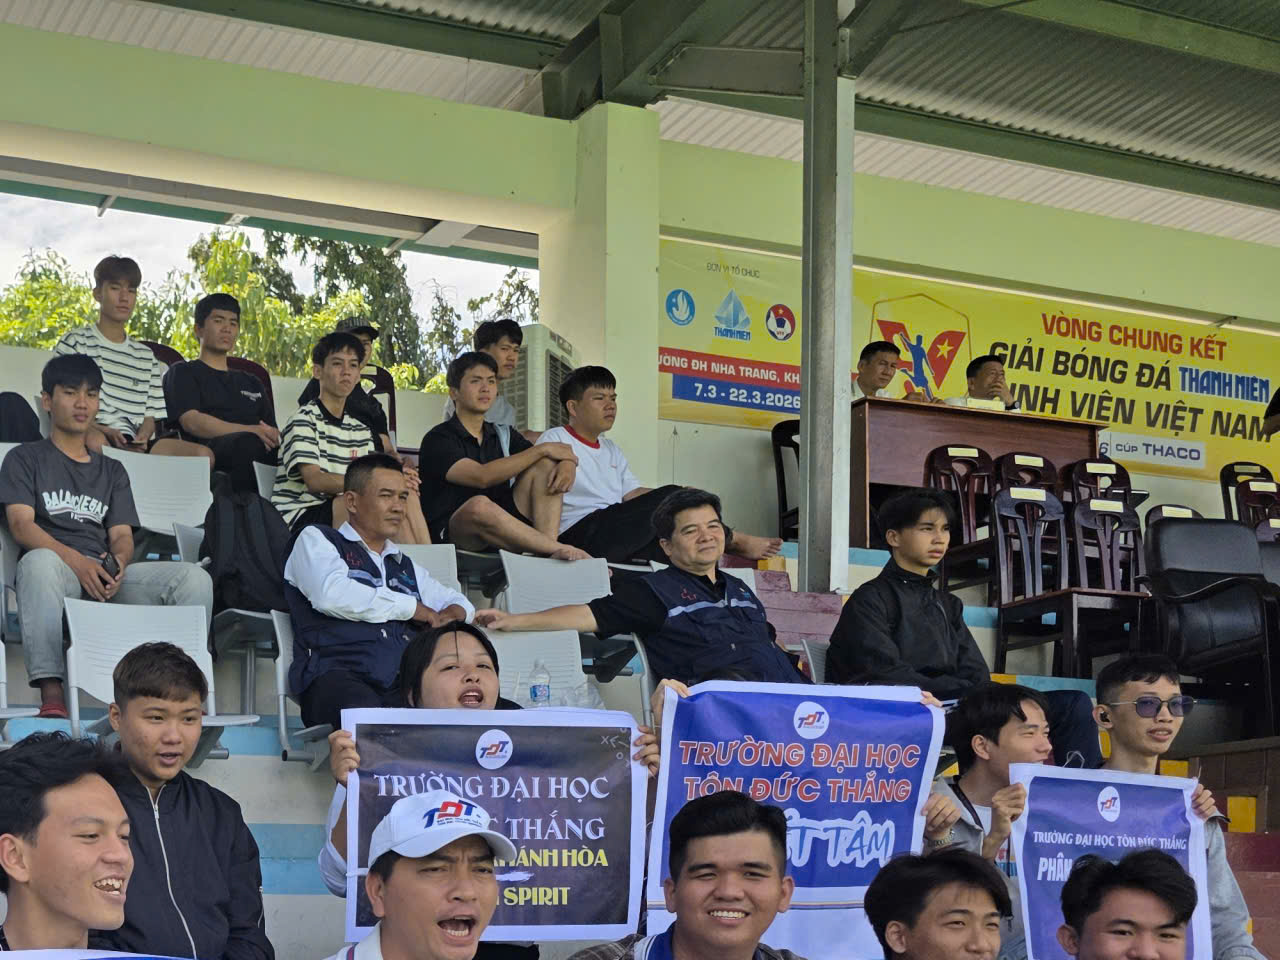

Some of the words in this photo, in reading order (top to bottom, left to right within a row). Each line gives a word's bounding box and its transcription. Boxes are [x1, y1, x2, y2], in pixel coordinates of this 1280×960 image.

[1041, 310, 1103, 343] VÒNG
[1108, 324, 1183, 355] CHUNG
[1189, 334, 1228, 361] KẾT
[659, 355, 688, 369] ƯỜNG
[691, 359, 708, 371] ĐH
[711, 363, 736, 376] NHA
[738, 366, 780, 383] TRANG,
[989, 337, 1044, 373] GIẢI
[1051, 347, 1128, 385] BÓNG
[1135, 359, 1171, 391] ĐÁ
[694, 383, 717, 398] 7.3
[729, 388, 801, 409] 22.3.2026
[1009, 383, 1061, 415] INH
[1070, 389, 1135, 425] VIÊN
[1145, 399, 1205, 437] VIỆT
[1211, 410, 1271, 443] NAM
[1115, 441, 1138, 453] CÚP
[1142, 442, 1201, 461] THACO
[679, 735, 805, 767] TRƯỜNG
[811, 743, 858, 774] ĐẠI
[865, 743, 920, 774] HỌC
[373, 770, 484, 799] TRƯỜNG
[489, 775, 540, 803] ĐẠI
[548, 775, 610, 803] HỌC
[684, 771, 743, 801] TÔN
[750, 771, 821, 802] ĐỨC
[827, 770, 912, 802] THẮNG
[508, 809, 606, 841] THẮNG
[823, 816, 891, 861] TÂM
[1033, 829, 1074, 845] TRƯỜNG
[1075, 834, 1092, 848] ĐẠI
[1094, 835, 1114, 849] HỌC
[1117, 833, 1136, 848] TÔN
[1159, 834, 1187, 850] THẮNG
[562, 844, 608, 867] HÒA
[503, 886, 570, 906] SPIRIT
